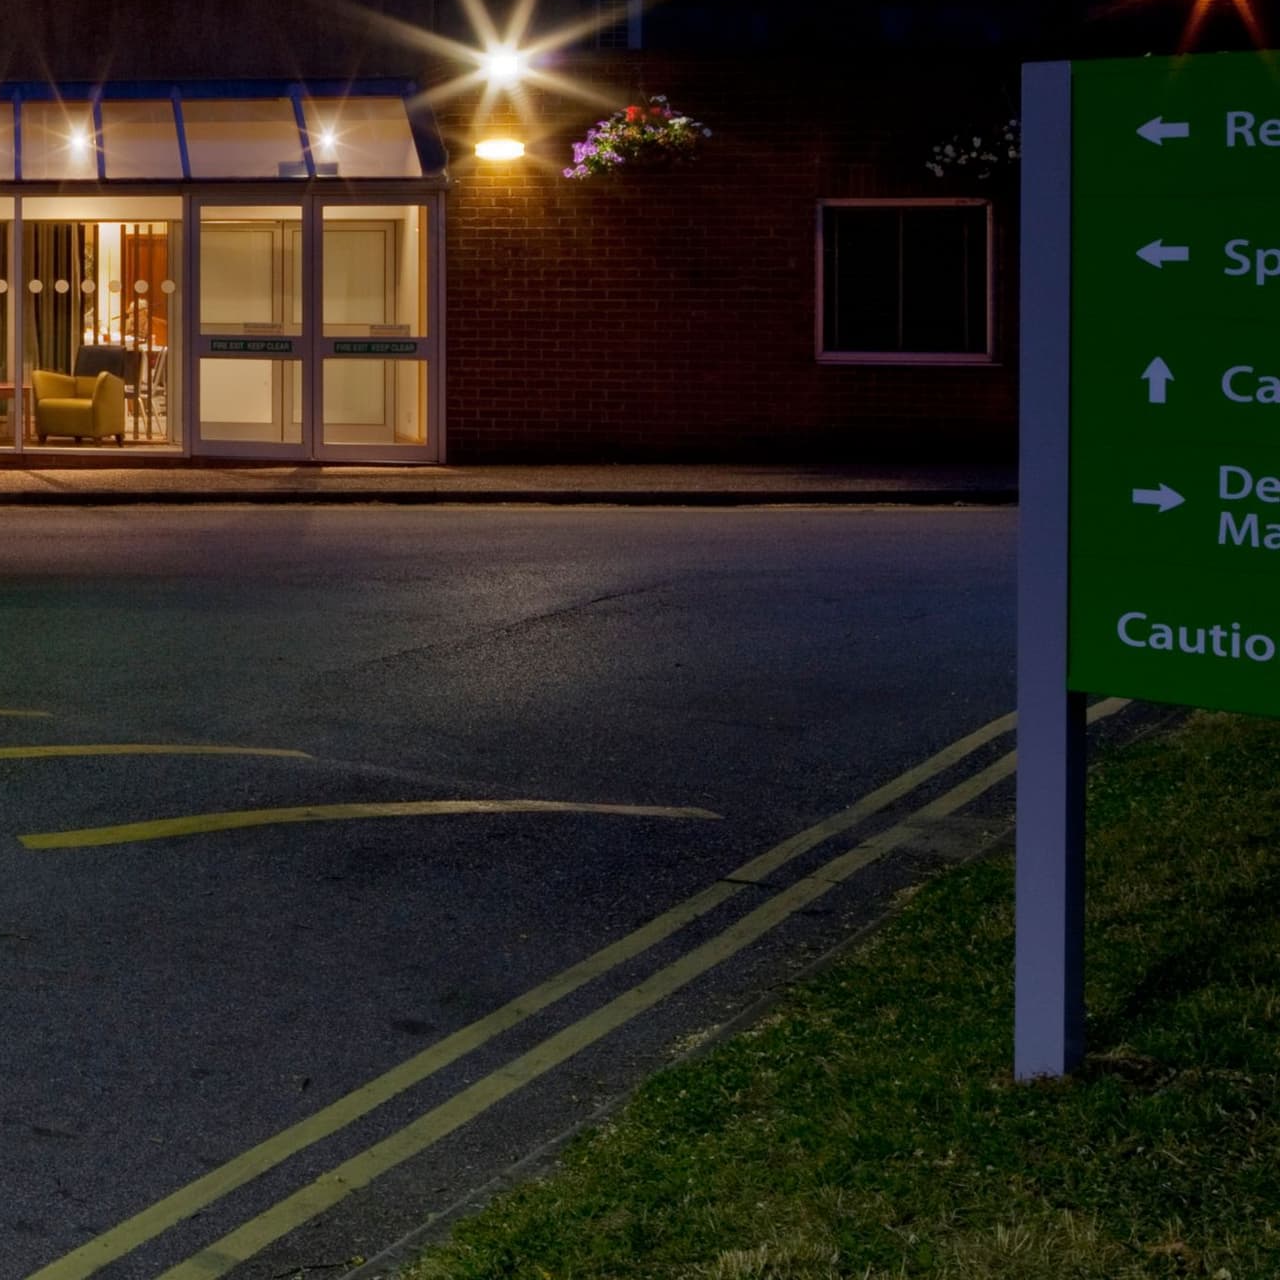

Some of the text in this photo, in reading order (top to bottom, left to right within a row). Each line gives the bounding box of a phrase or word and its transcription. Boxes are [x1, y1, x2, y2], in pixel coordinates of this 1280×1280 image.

[1226, 110, 1280, 147] Re
[1224, 238, 1280, 286] Sp
[247, 342, 265, 350] KEEP
[266, 342, 290, 350] CLEAR
[371, 343, 390, 351] KEEP
[391, 343, 415, 351] CLEAR
[1221, 365, 1280, 403] Ca
[1219, 465, 1280, 503] De
[1218, 511, 1280, 549] Ma
[1117, 611, 1275, 662] Cautio
